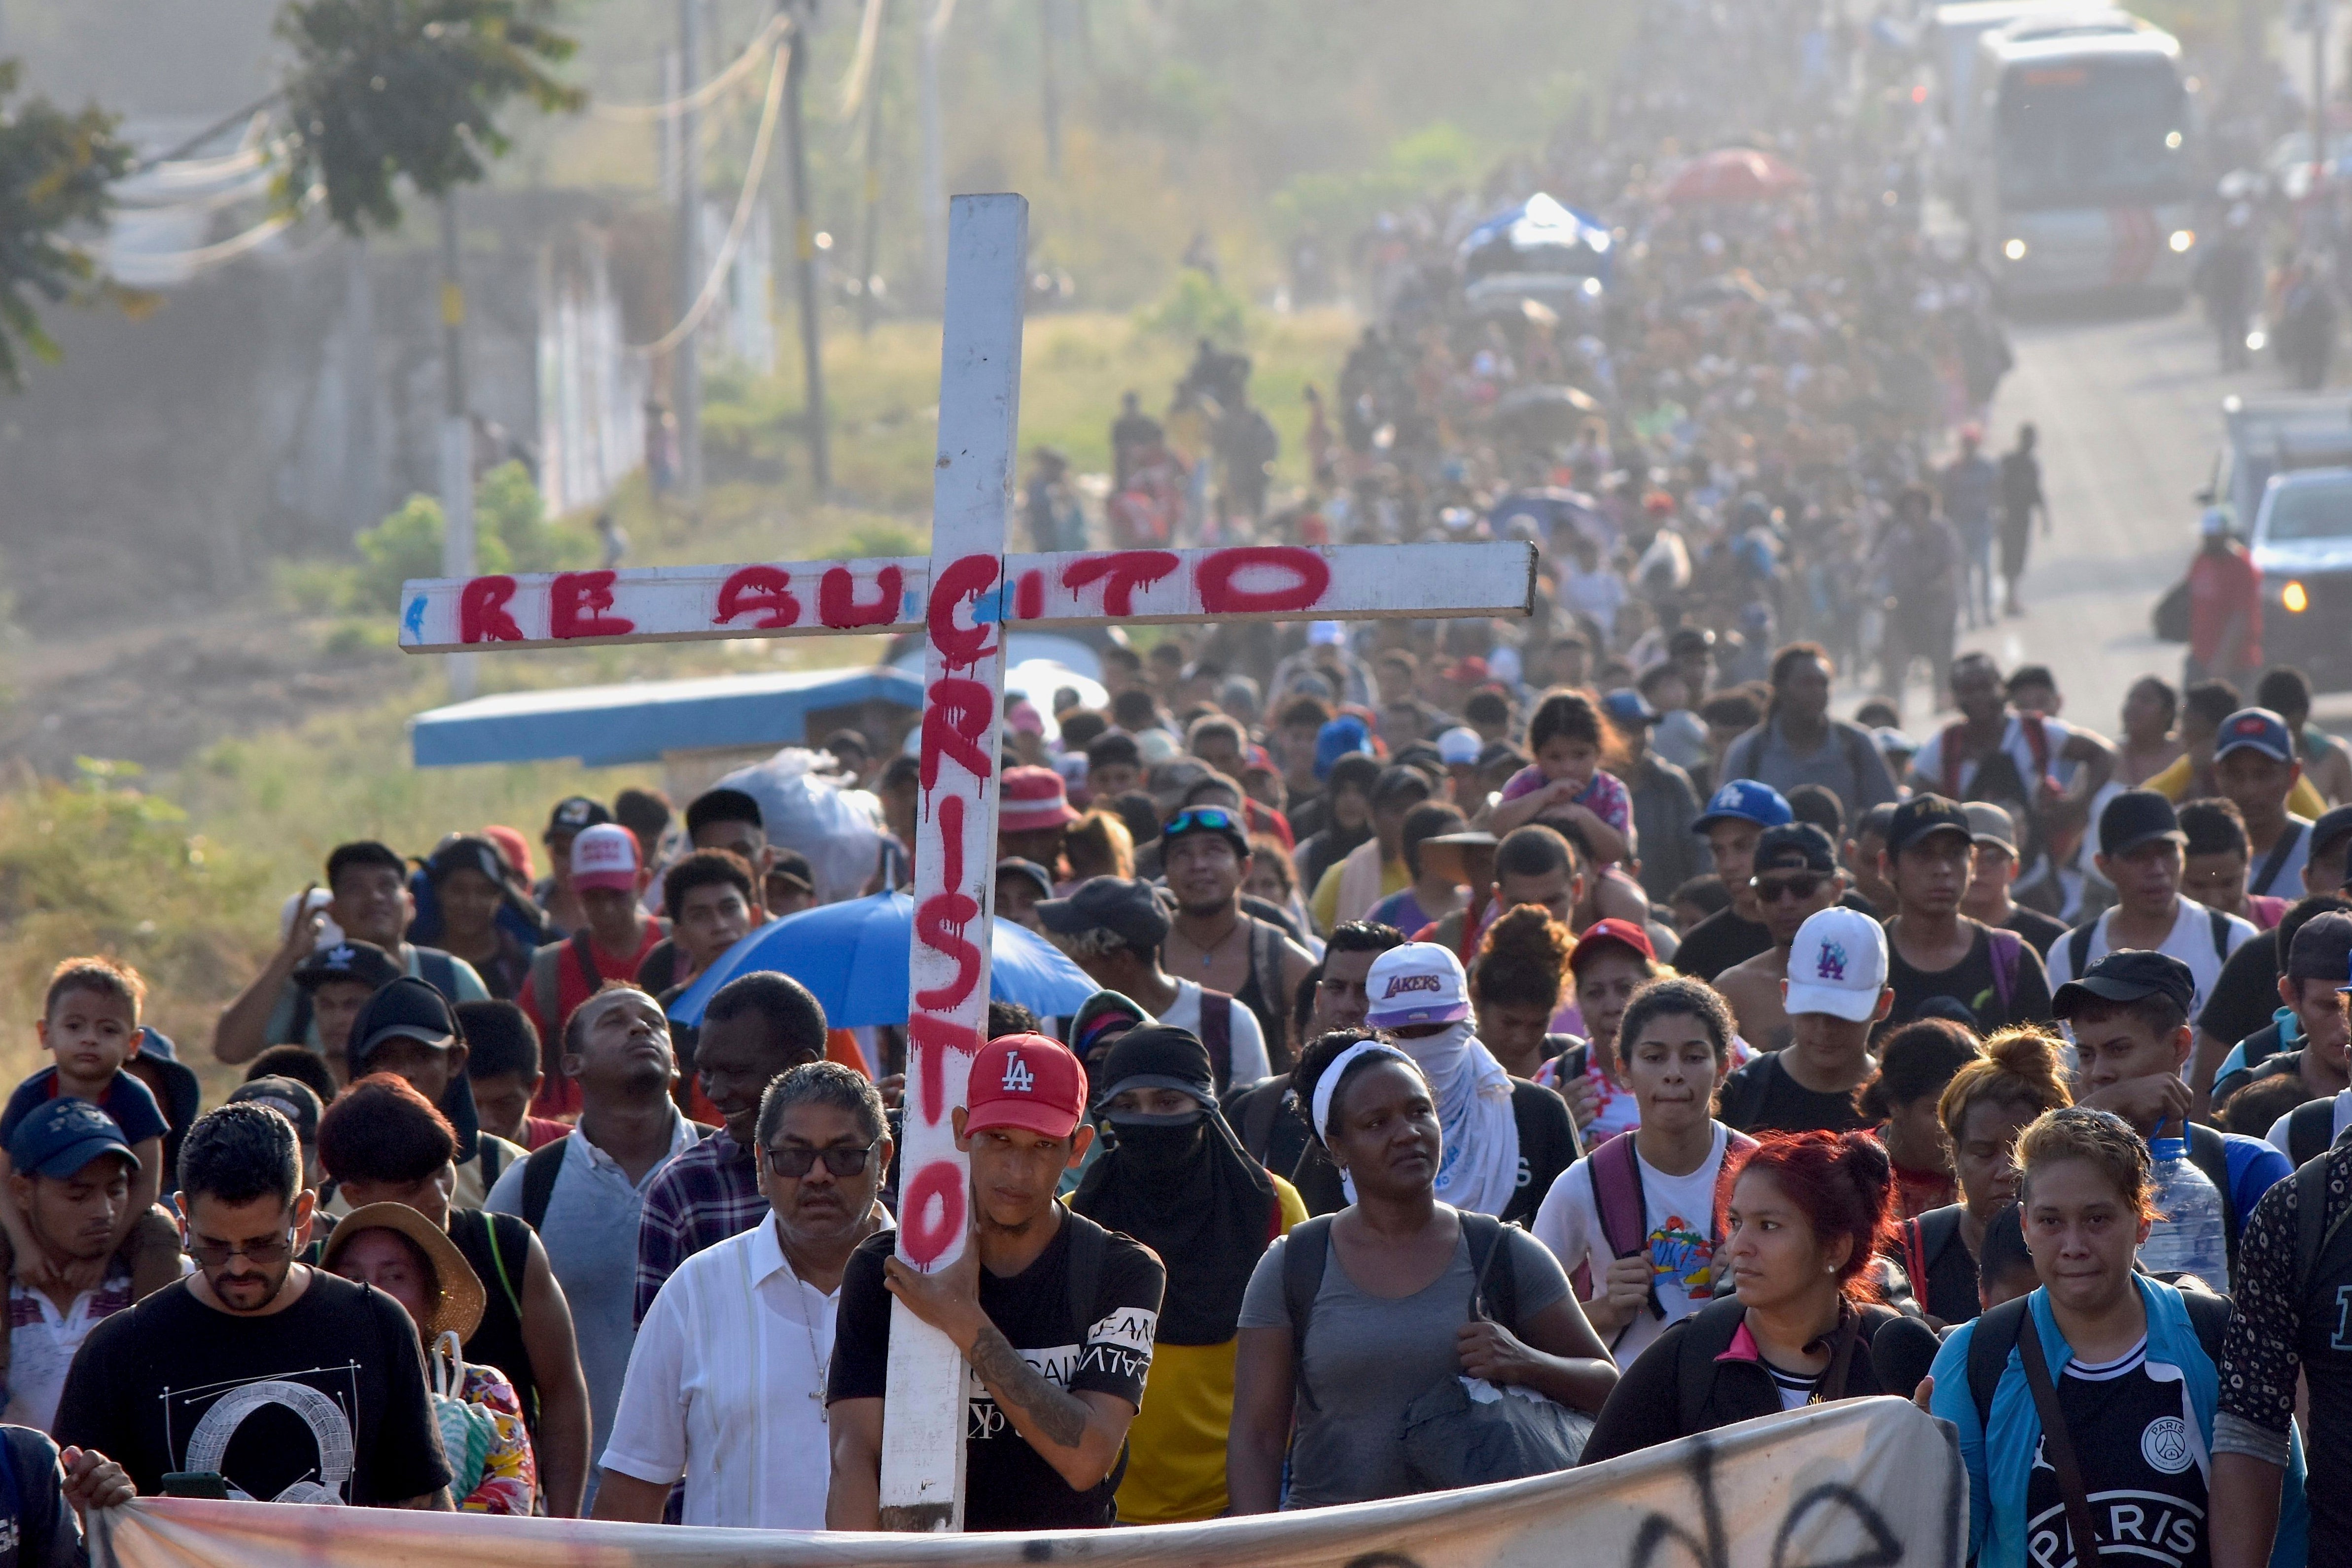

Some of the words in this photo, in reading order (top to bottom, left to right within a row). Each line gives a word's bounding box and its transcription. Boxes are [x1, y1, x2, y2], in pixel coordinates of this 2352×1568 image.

[900, 554, 998, 1269] CRISTO
[1817, 943, 1844, 980] LA
[1381, 975, 1441, 1000] LAKERS
[1001, 1051, 1034, 1091] LA
[2151, 1422, 2185, 1435] PARIS
